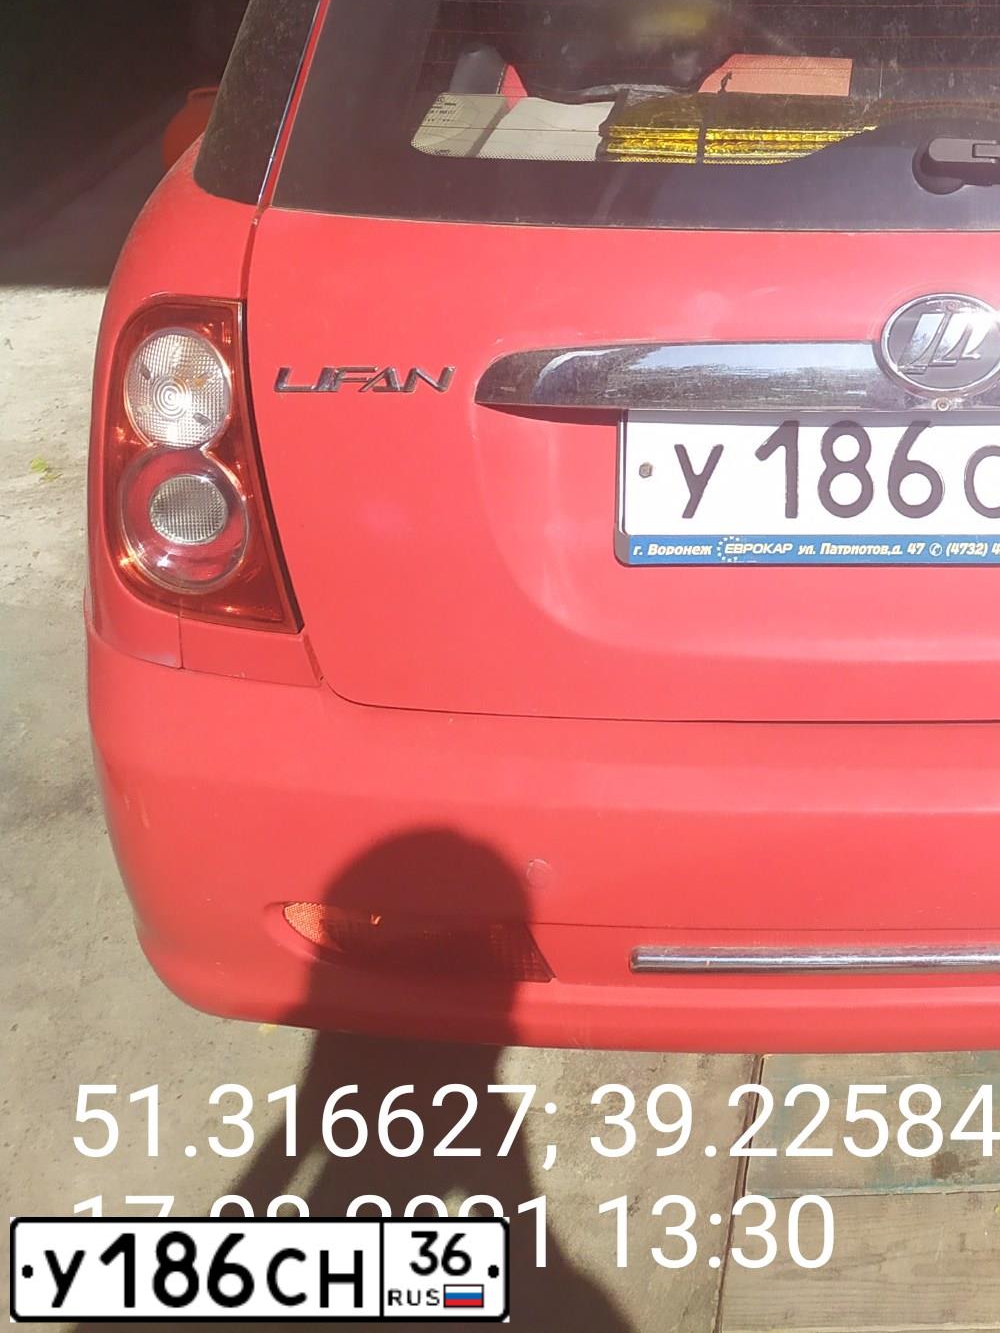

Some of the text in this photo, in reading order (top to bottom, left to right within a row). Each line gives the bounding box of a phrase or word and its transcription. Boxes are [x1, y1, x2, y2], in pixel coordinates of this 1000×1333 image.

[274, 366, 456, 393] LIFAN
[633, 544, 644, 556] г.
[647, 543, 713, 556] Воронеж
[724, 543, 793, 554] ЕВРОКАР
[798, 545, 816, 556] ул.
[907, 543, 923, 555] 47
[945, 542, 988, 557] (4732)
